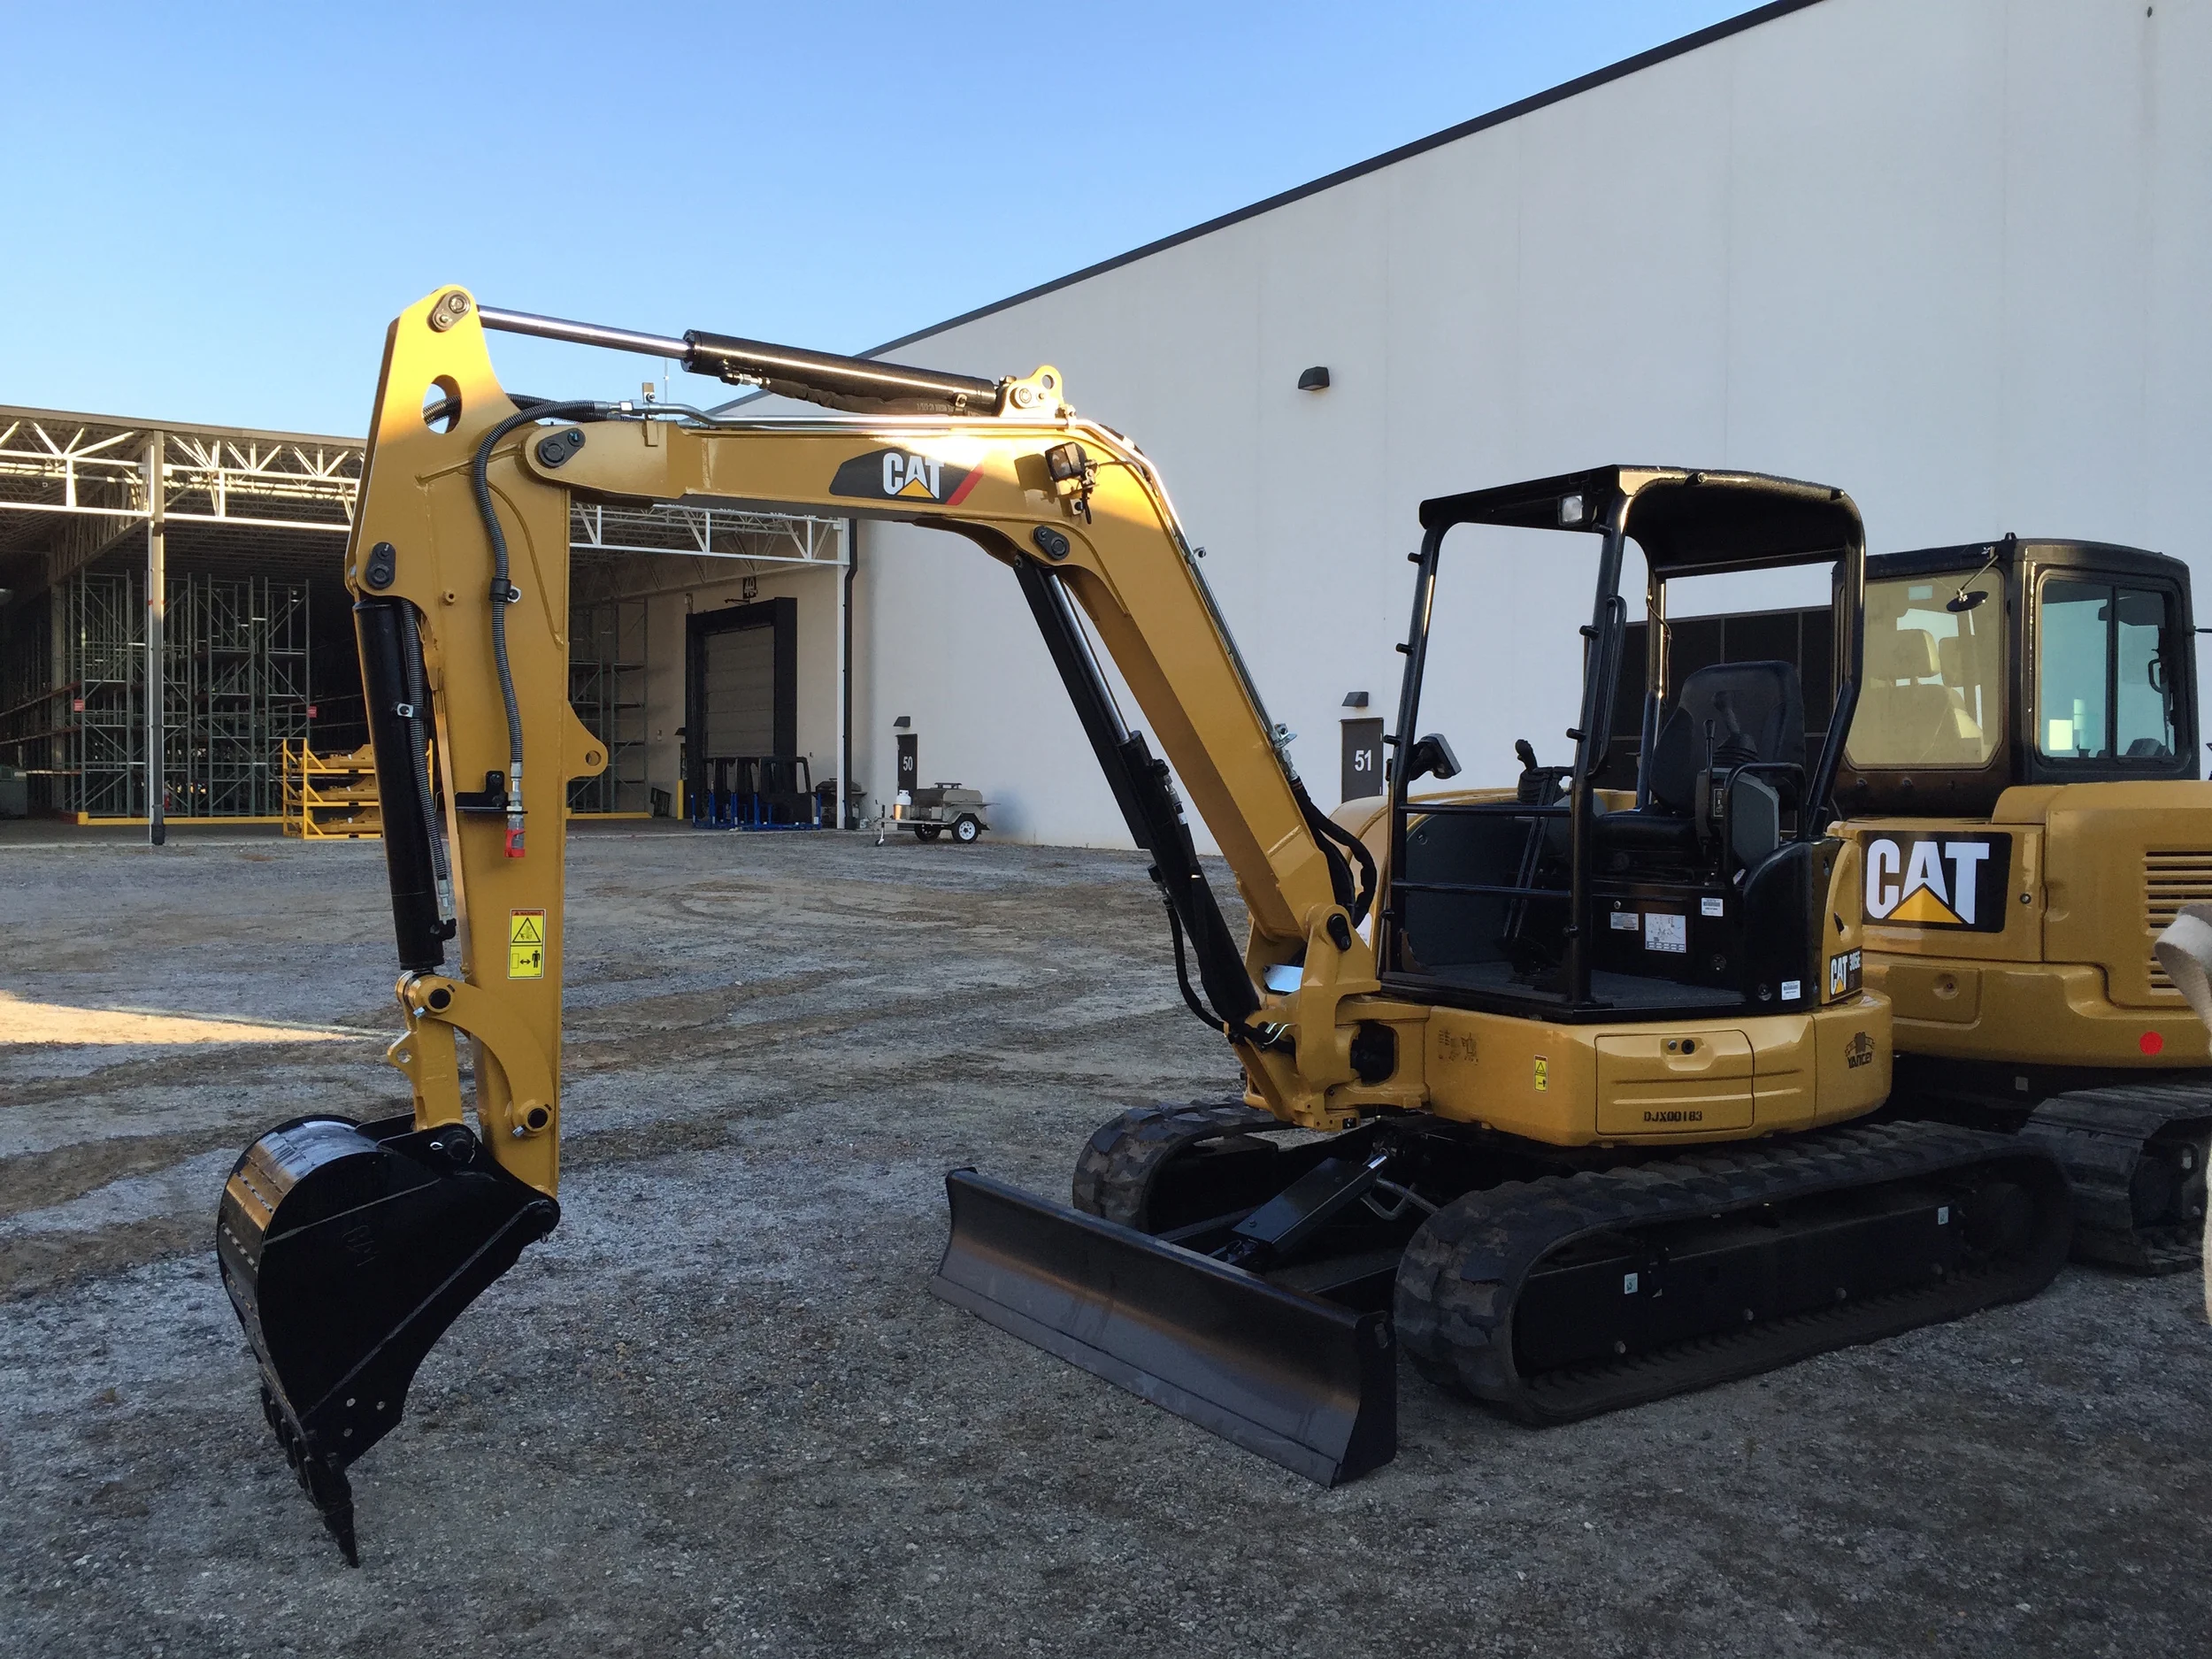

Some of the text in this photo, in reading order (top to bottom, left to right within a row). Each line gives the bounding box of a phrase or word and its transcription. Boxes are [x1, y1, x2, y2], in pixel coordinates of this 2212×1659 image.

[883, 452, 945, 500] CAT
[902, 756, 913, 772] 50
[1355, 749, 1371, 772] 51
[1866, 839, 1990, 925] CAT
[1831, 956, 1847, 995] CAT
[1643, 1110, 1703, 1123] DJX00183
